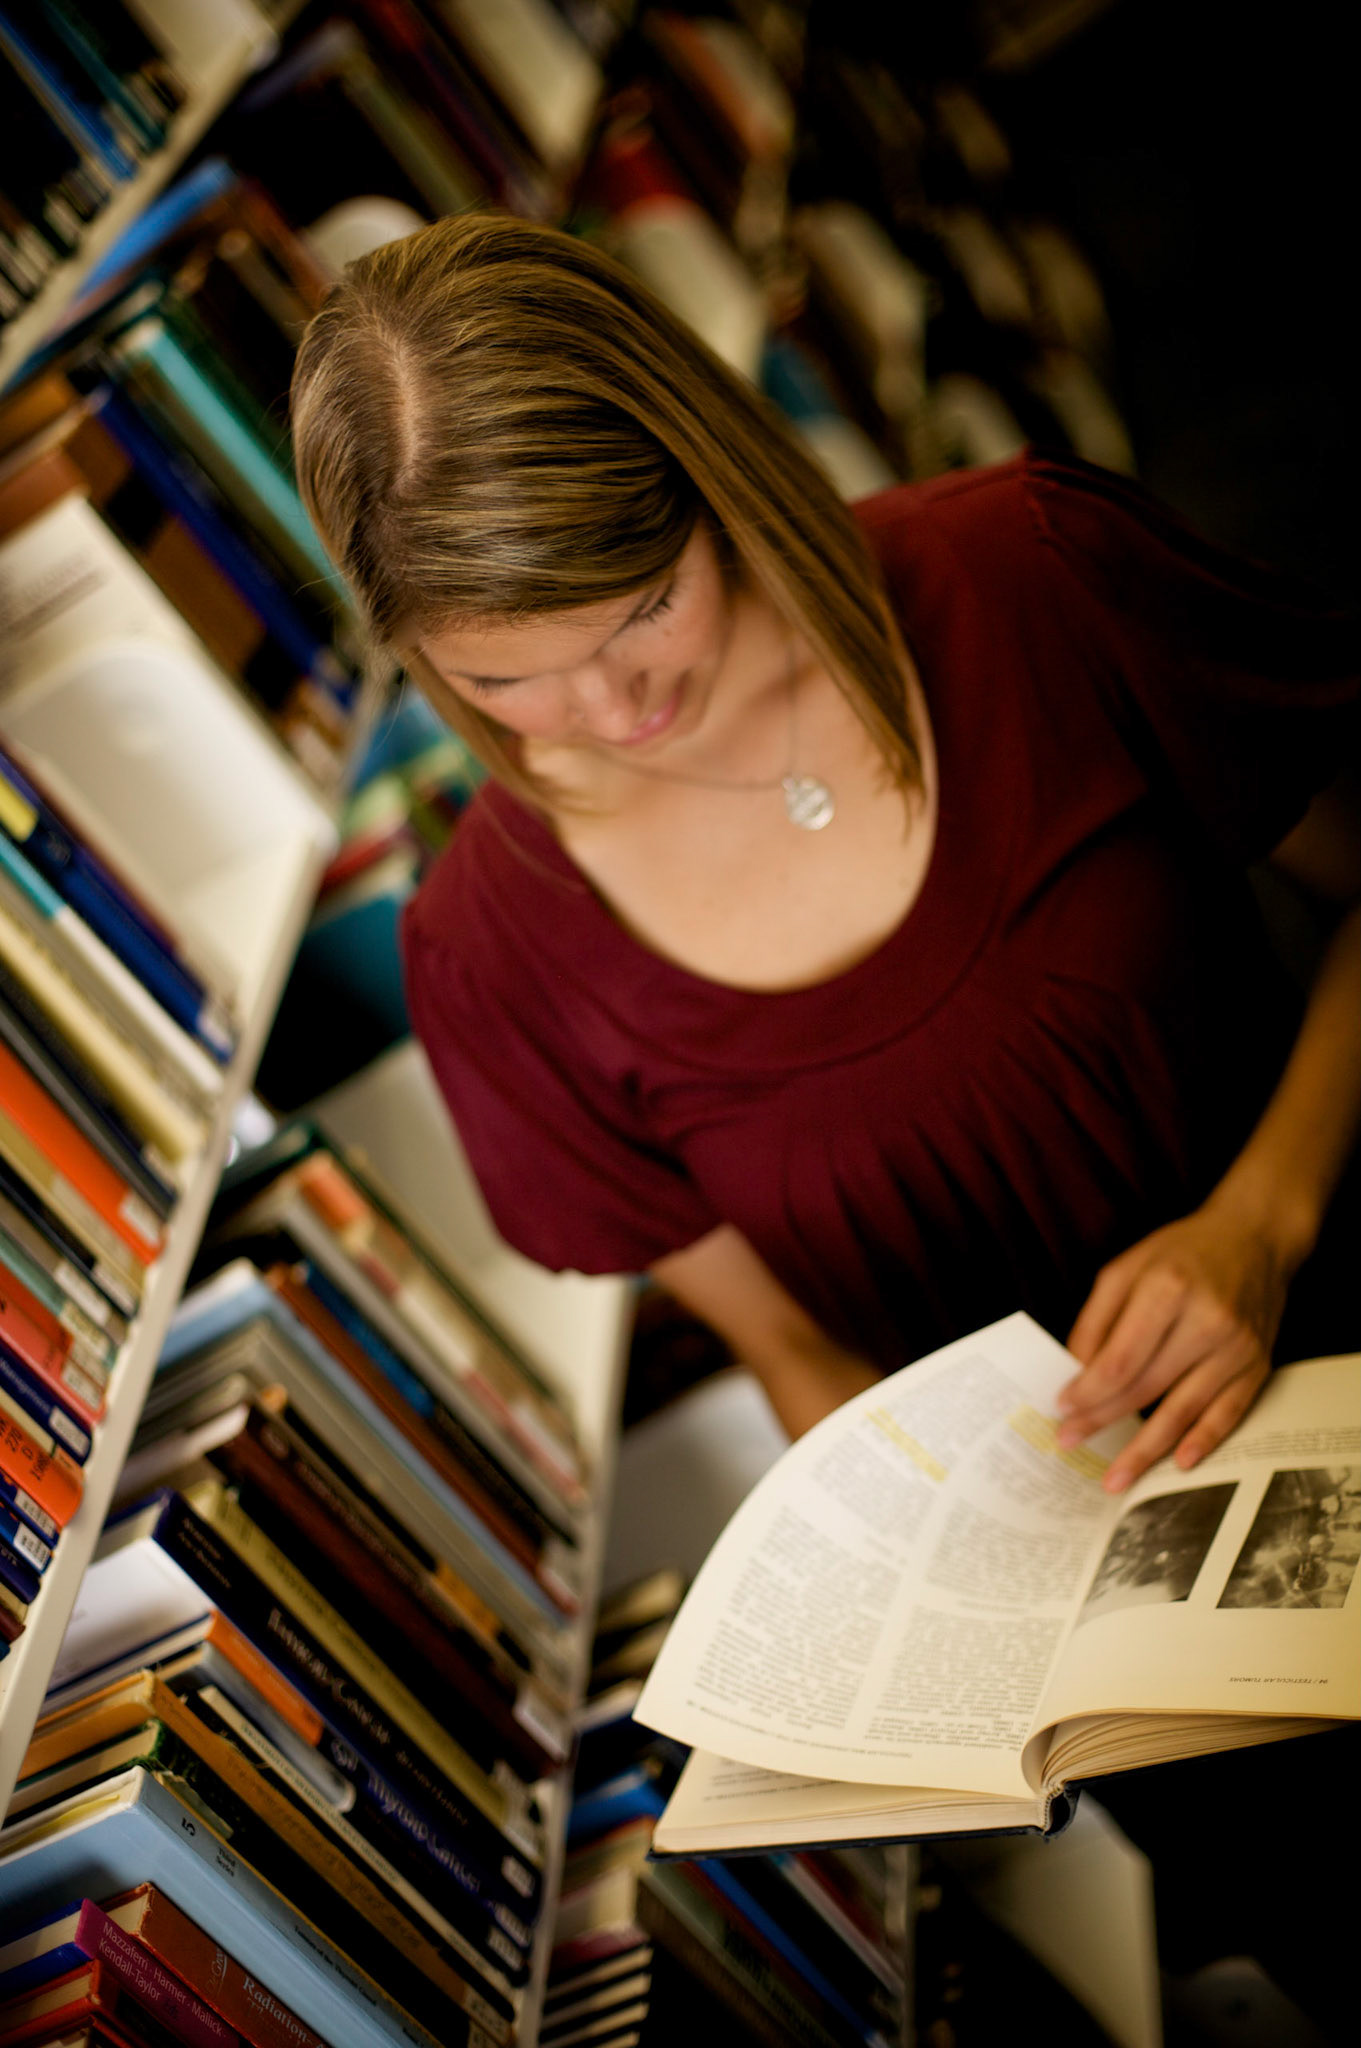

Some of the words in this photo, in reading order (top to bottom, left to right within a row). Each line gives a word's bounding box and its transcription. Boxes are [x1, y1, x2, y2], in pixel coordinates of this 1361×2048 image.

[181, 1817, 196, 1837] 5
[216, 1855, 234, 1877] Series
[218, 1847, 236, 1867] Third
[99, 1939, 161, 2001] Kendall-Taylor
[102, 1921, 149, 1971] Mazzaferri
[153, 1963, 187, 2004] Harmer
[191, 2004, 223, 2037] Mallick
